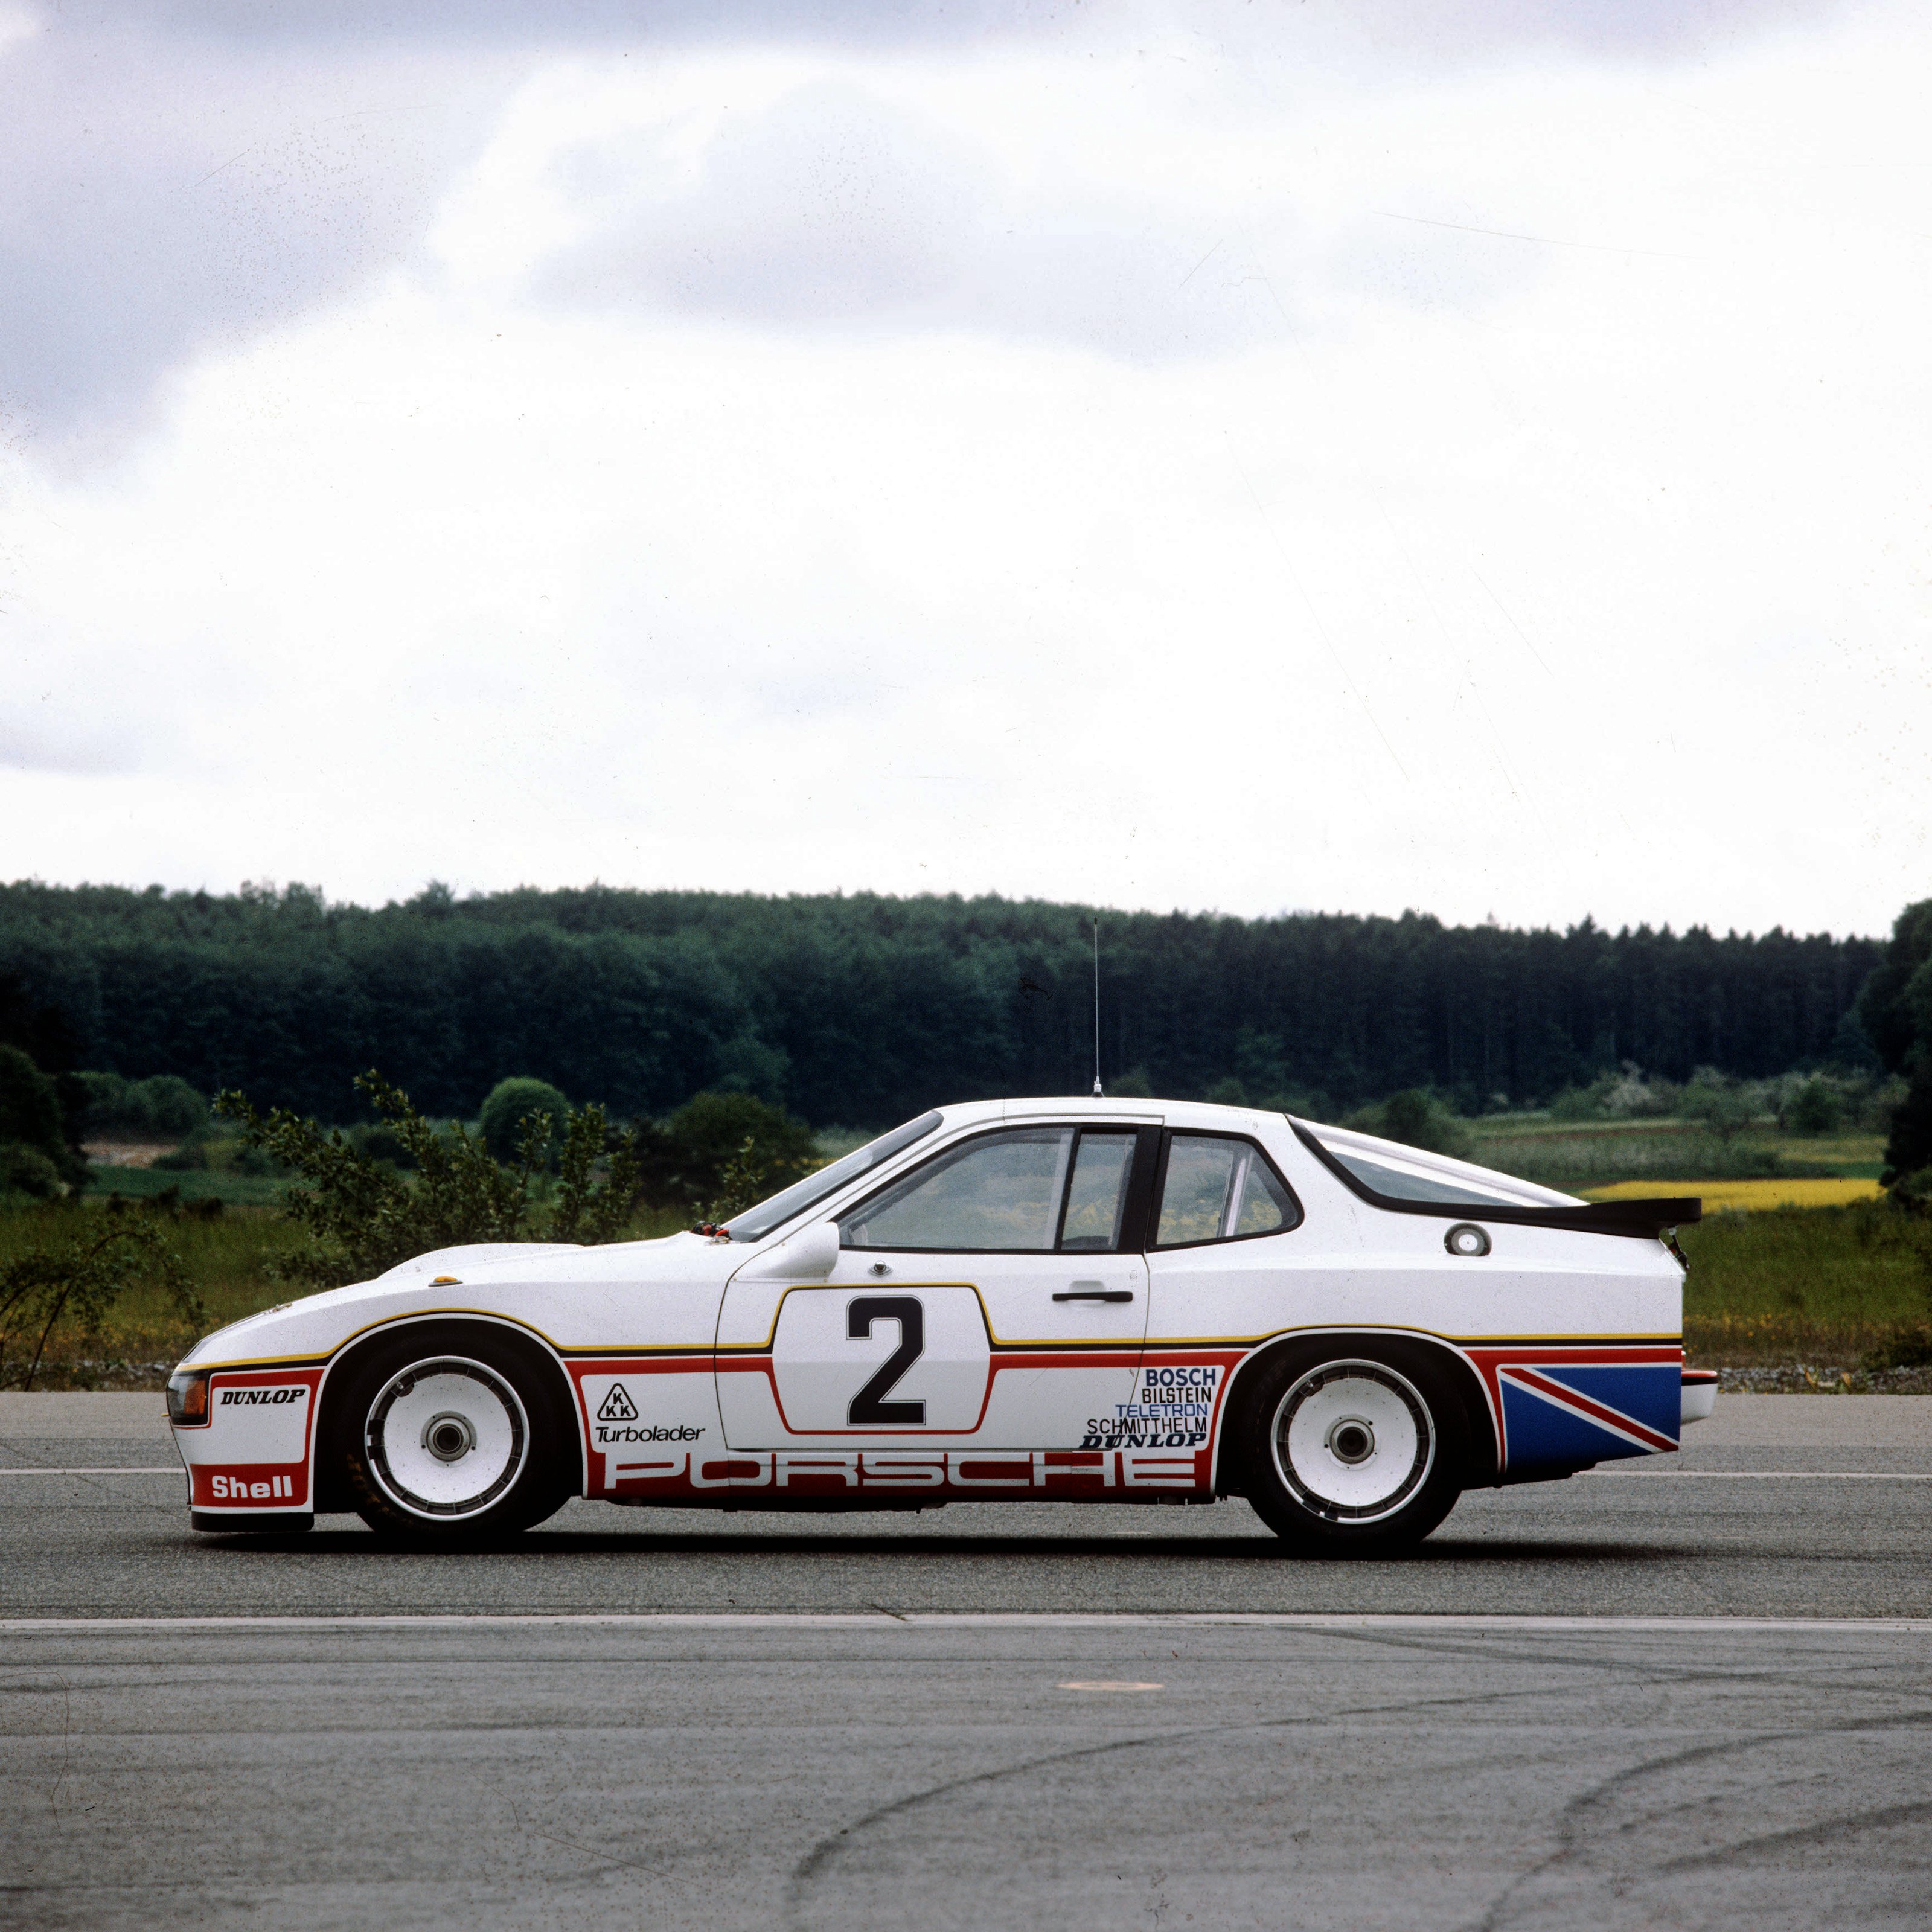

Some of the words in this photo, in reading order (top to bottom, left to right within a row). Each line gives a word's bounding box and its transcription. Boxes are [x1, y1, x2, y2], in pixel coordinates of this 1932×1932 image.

[846, 1295, 926, 1425] 2
[1145, 1367, 1216, 1387] BOSCH
[220, 1389, 306, 1405] DUNLOP
[1142, 1387, 1212, 1404] BILSTEIN
[1115, 1404, 1208, 1418] TELETRON
[595, 1425, 706, 1443] Turbolader
[1087, 1417, 1207, 1435] SCHMITTHELM
[1078, 1433, 1207, 1449] DUNLOP
[604, 1450, 1196, 1489] PORSCHE
[212, 1475, 293, 1499] Shell
